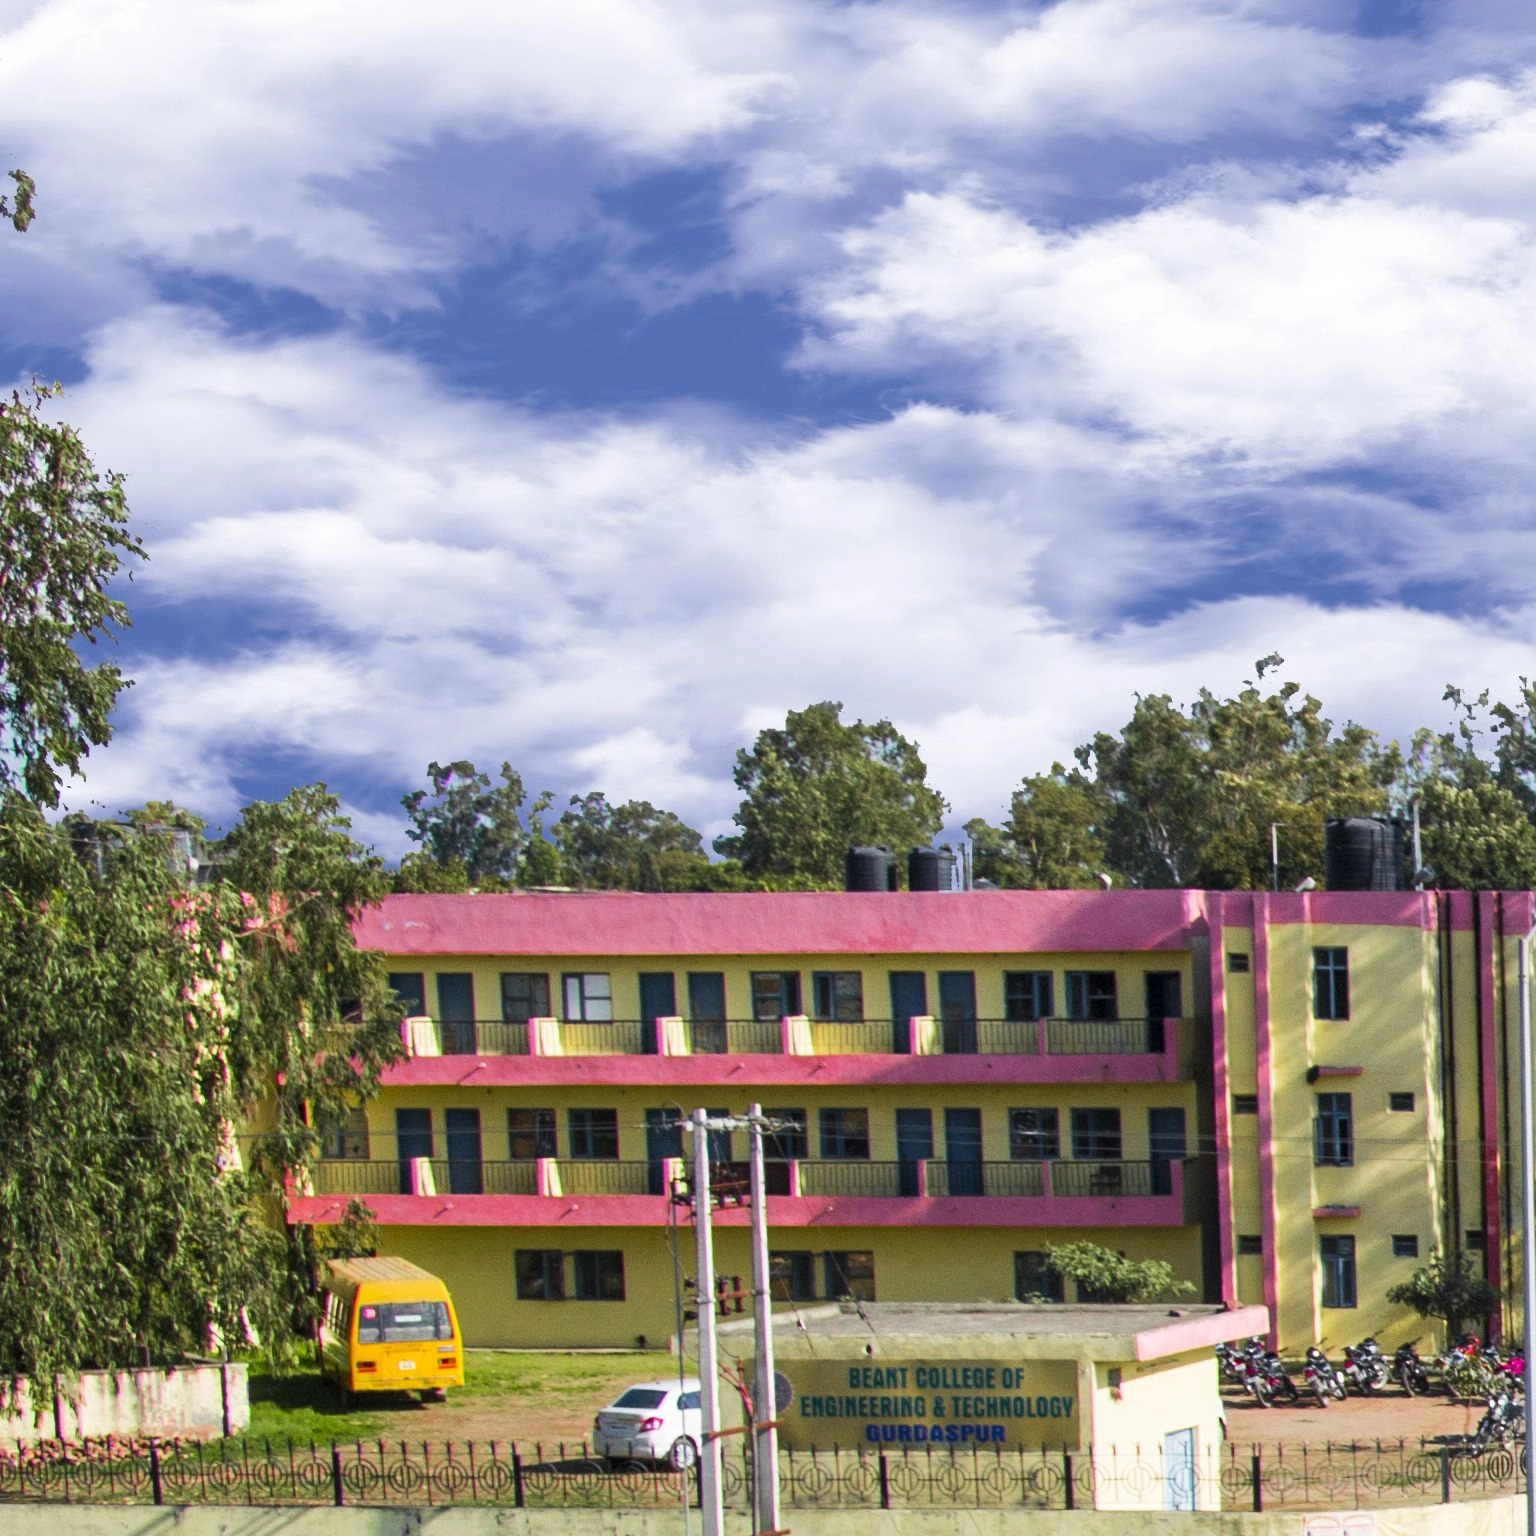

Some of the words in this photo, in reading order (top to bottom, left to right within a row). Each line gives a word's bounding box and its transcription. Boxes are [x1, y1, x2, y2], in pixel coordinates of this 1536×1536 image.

[848, 1368, 908, 1390] BEANT
[915, 1368, 996, 1389] COLLEGE
[1002, 1368, 1025, 1388] OF
[800, 1396, 926, 1418] ENGINEERING
[932, 1397, 946, 1417] &
[951, 1396, 1073, 1418] TECHNOLOGY
[865, 1424, 1006, 1443] GURDASPUR
